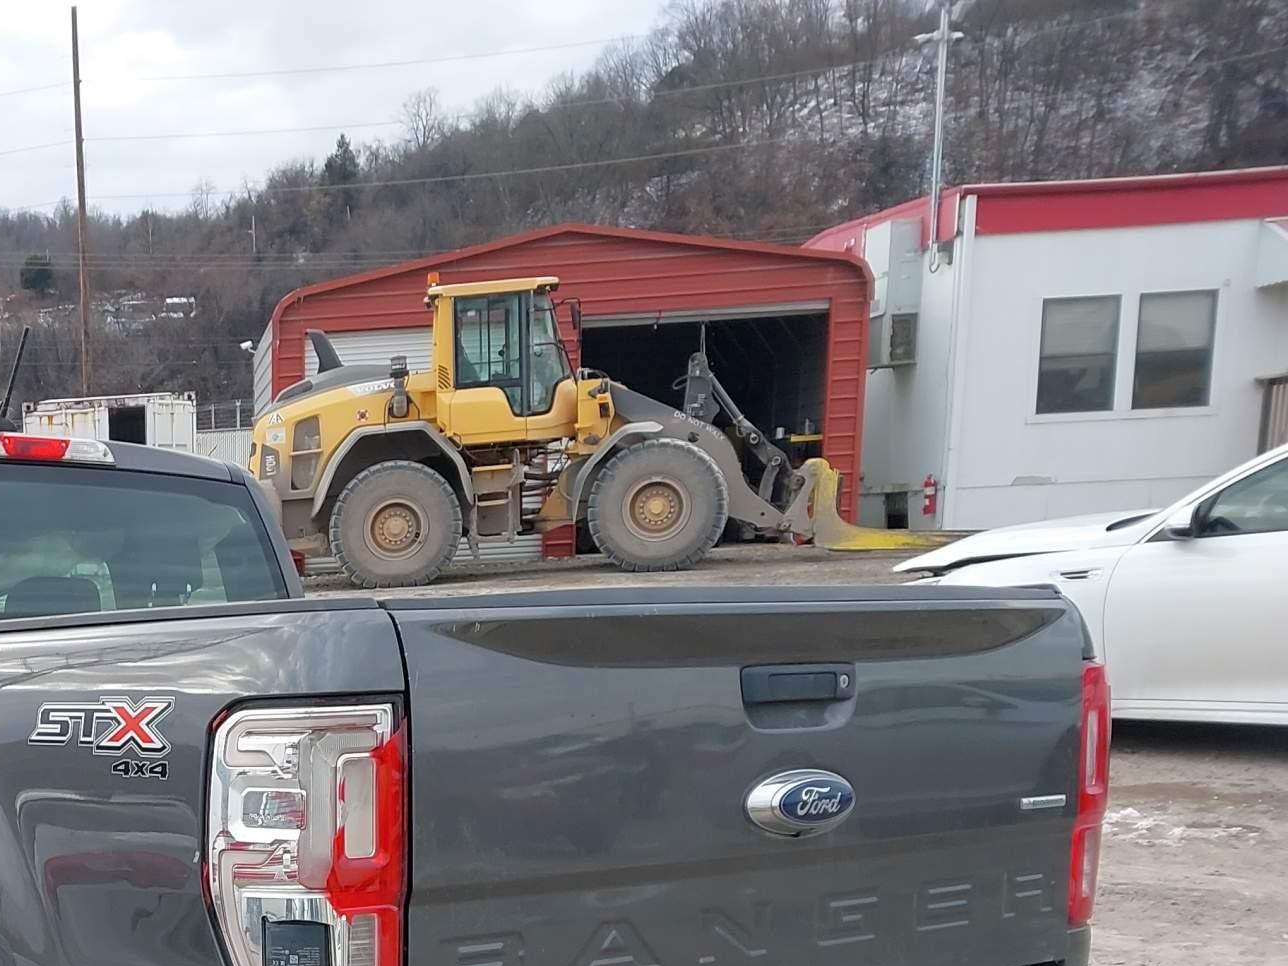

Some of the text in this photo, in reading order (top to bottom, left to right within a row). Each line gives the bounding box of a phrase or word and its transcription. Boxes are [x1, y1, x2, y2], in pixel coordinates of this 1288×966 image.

[674, 410, 686, 421] DO
[688, 416, 704, 429] NOT
[28, 696, 175, 758] STX
[797, 786, 842, 816] Ford
